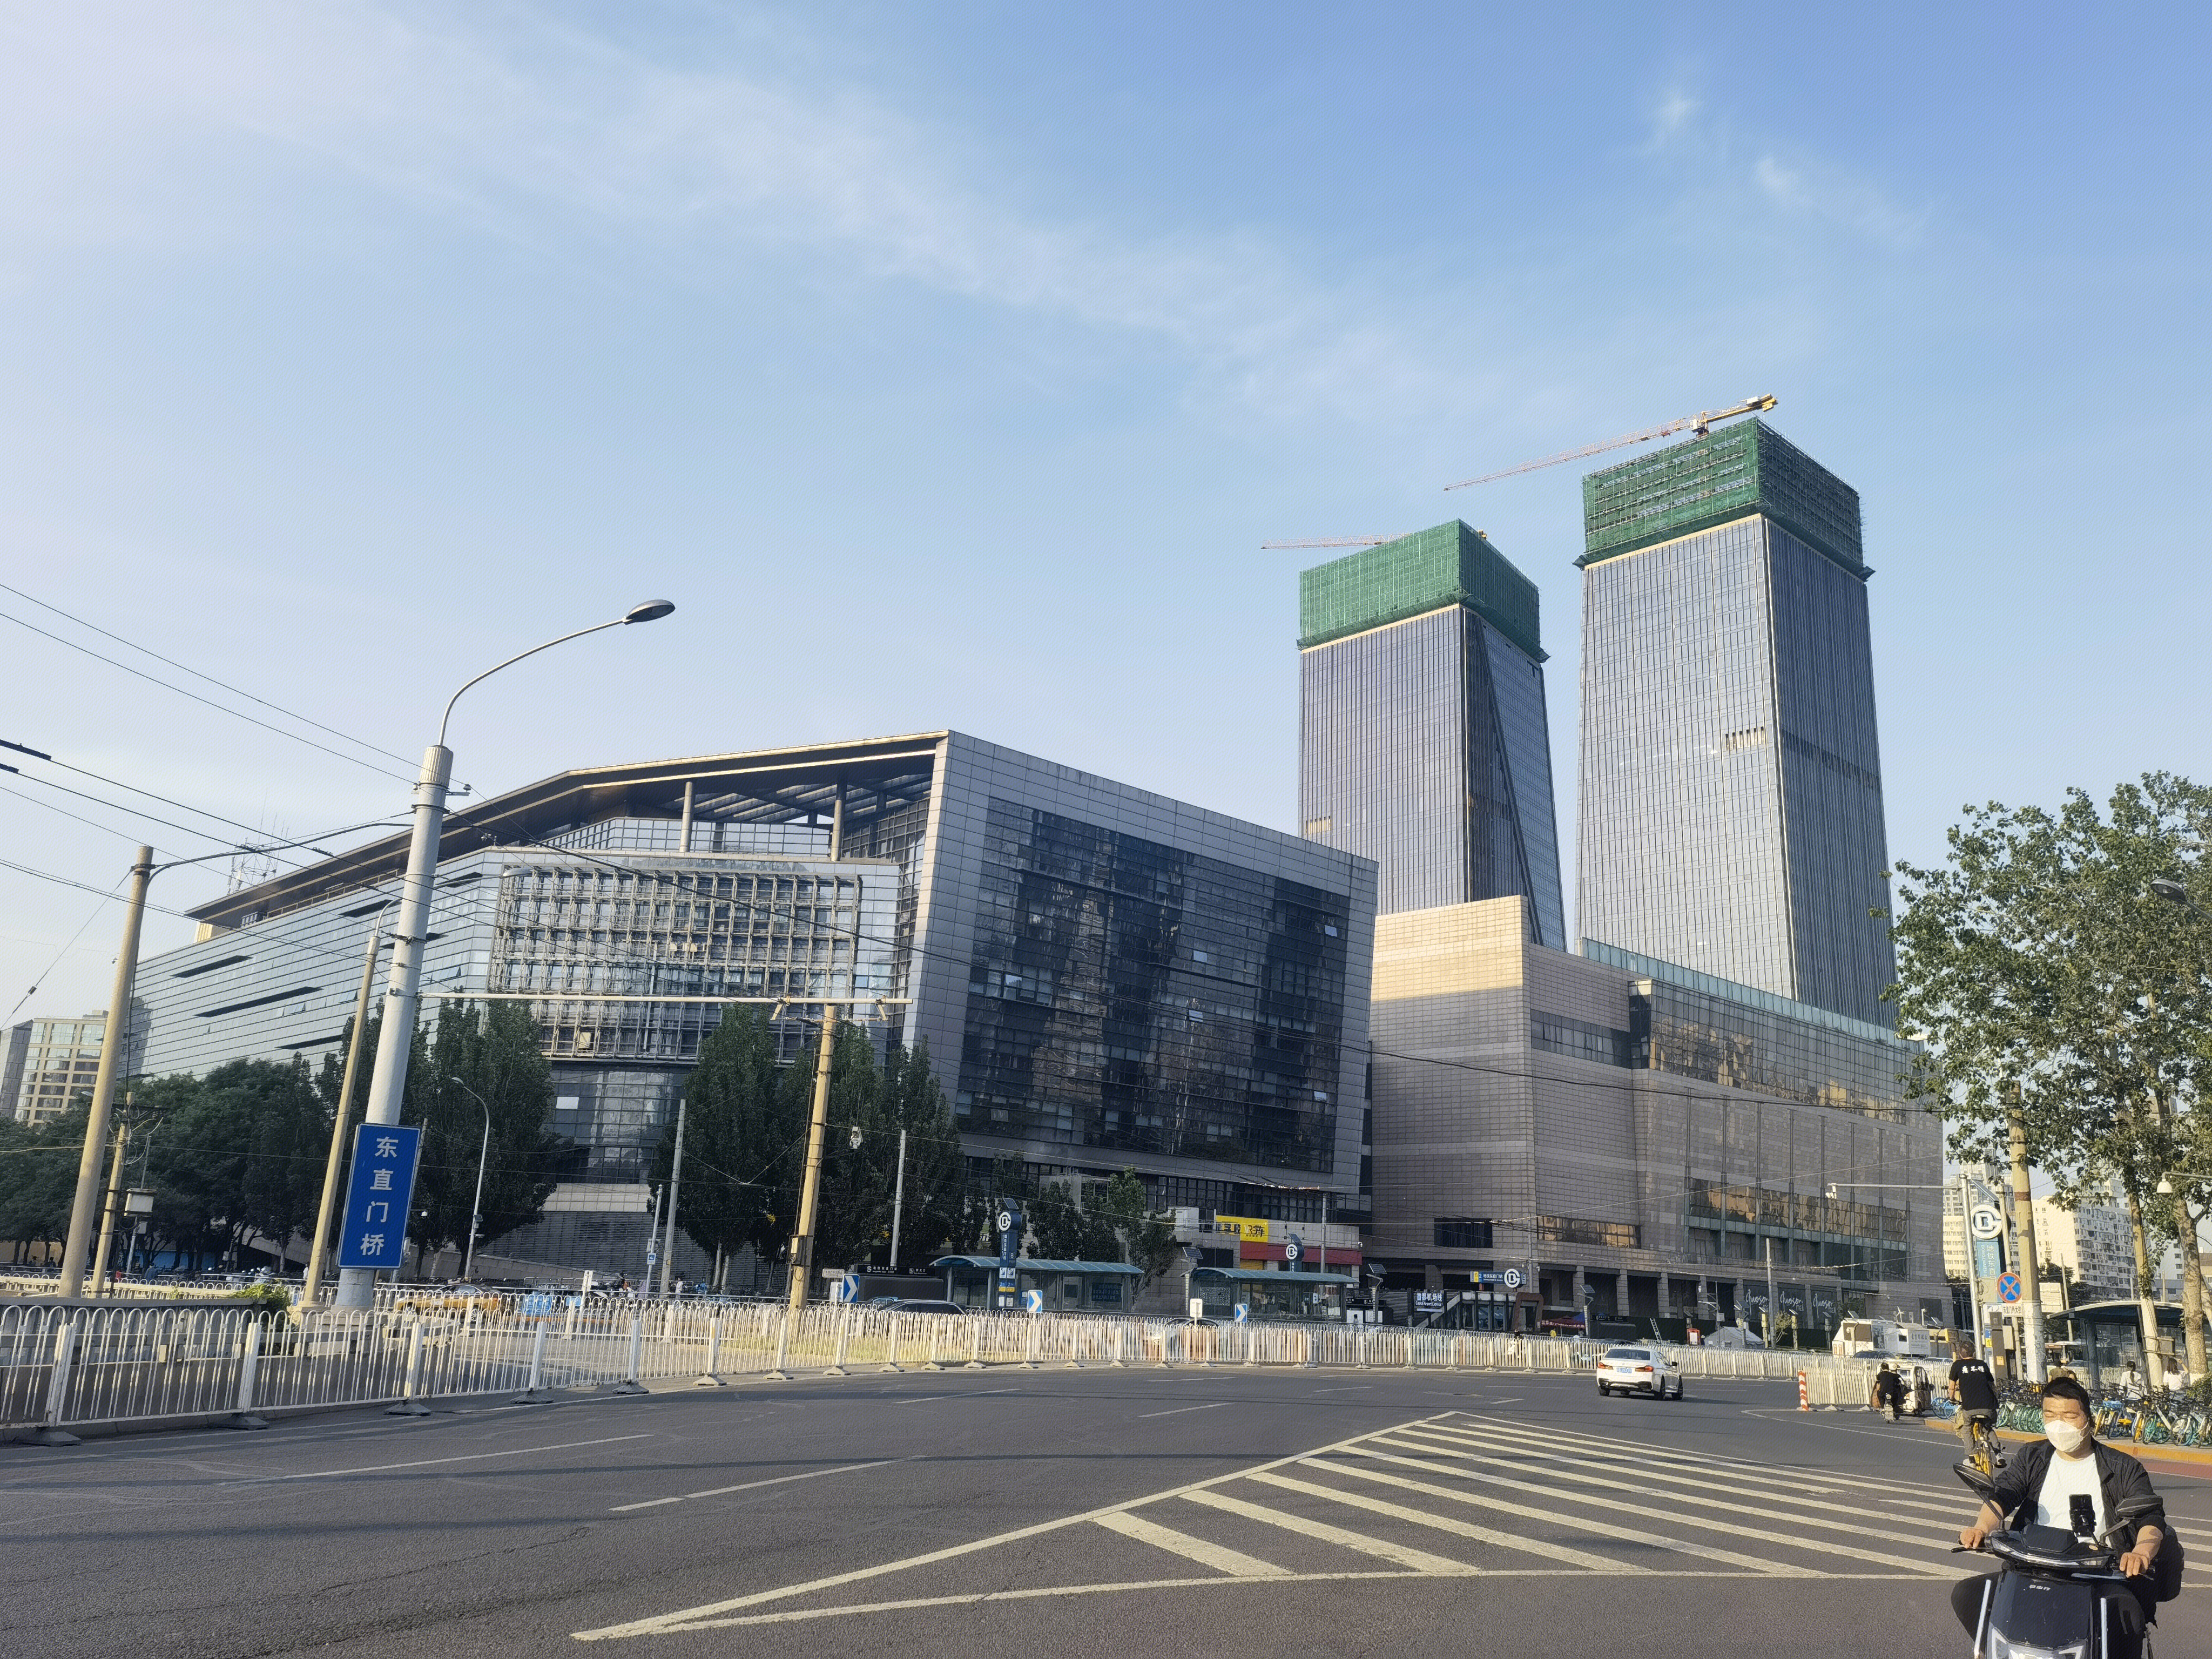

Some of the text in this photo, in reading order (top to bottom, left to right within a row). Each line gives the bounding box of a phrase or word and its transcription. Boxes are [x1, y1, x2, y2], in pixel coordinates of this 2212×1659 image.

[360, 1136, 399, 1256] 东直门桥
[1417, 1292, 1442, 1301] 首都机场线
